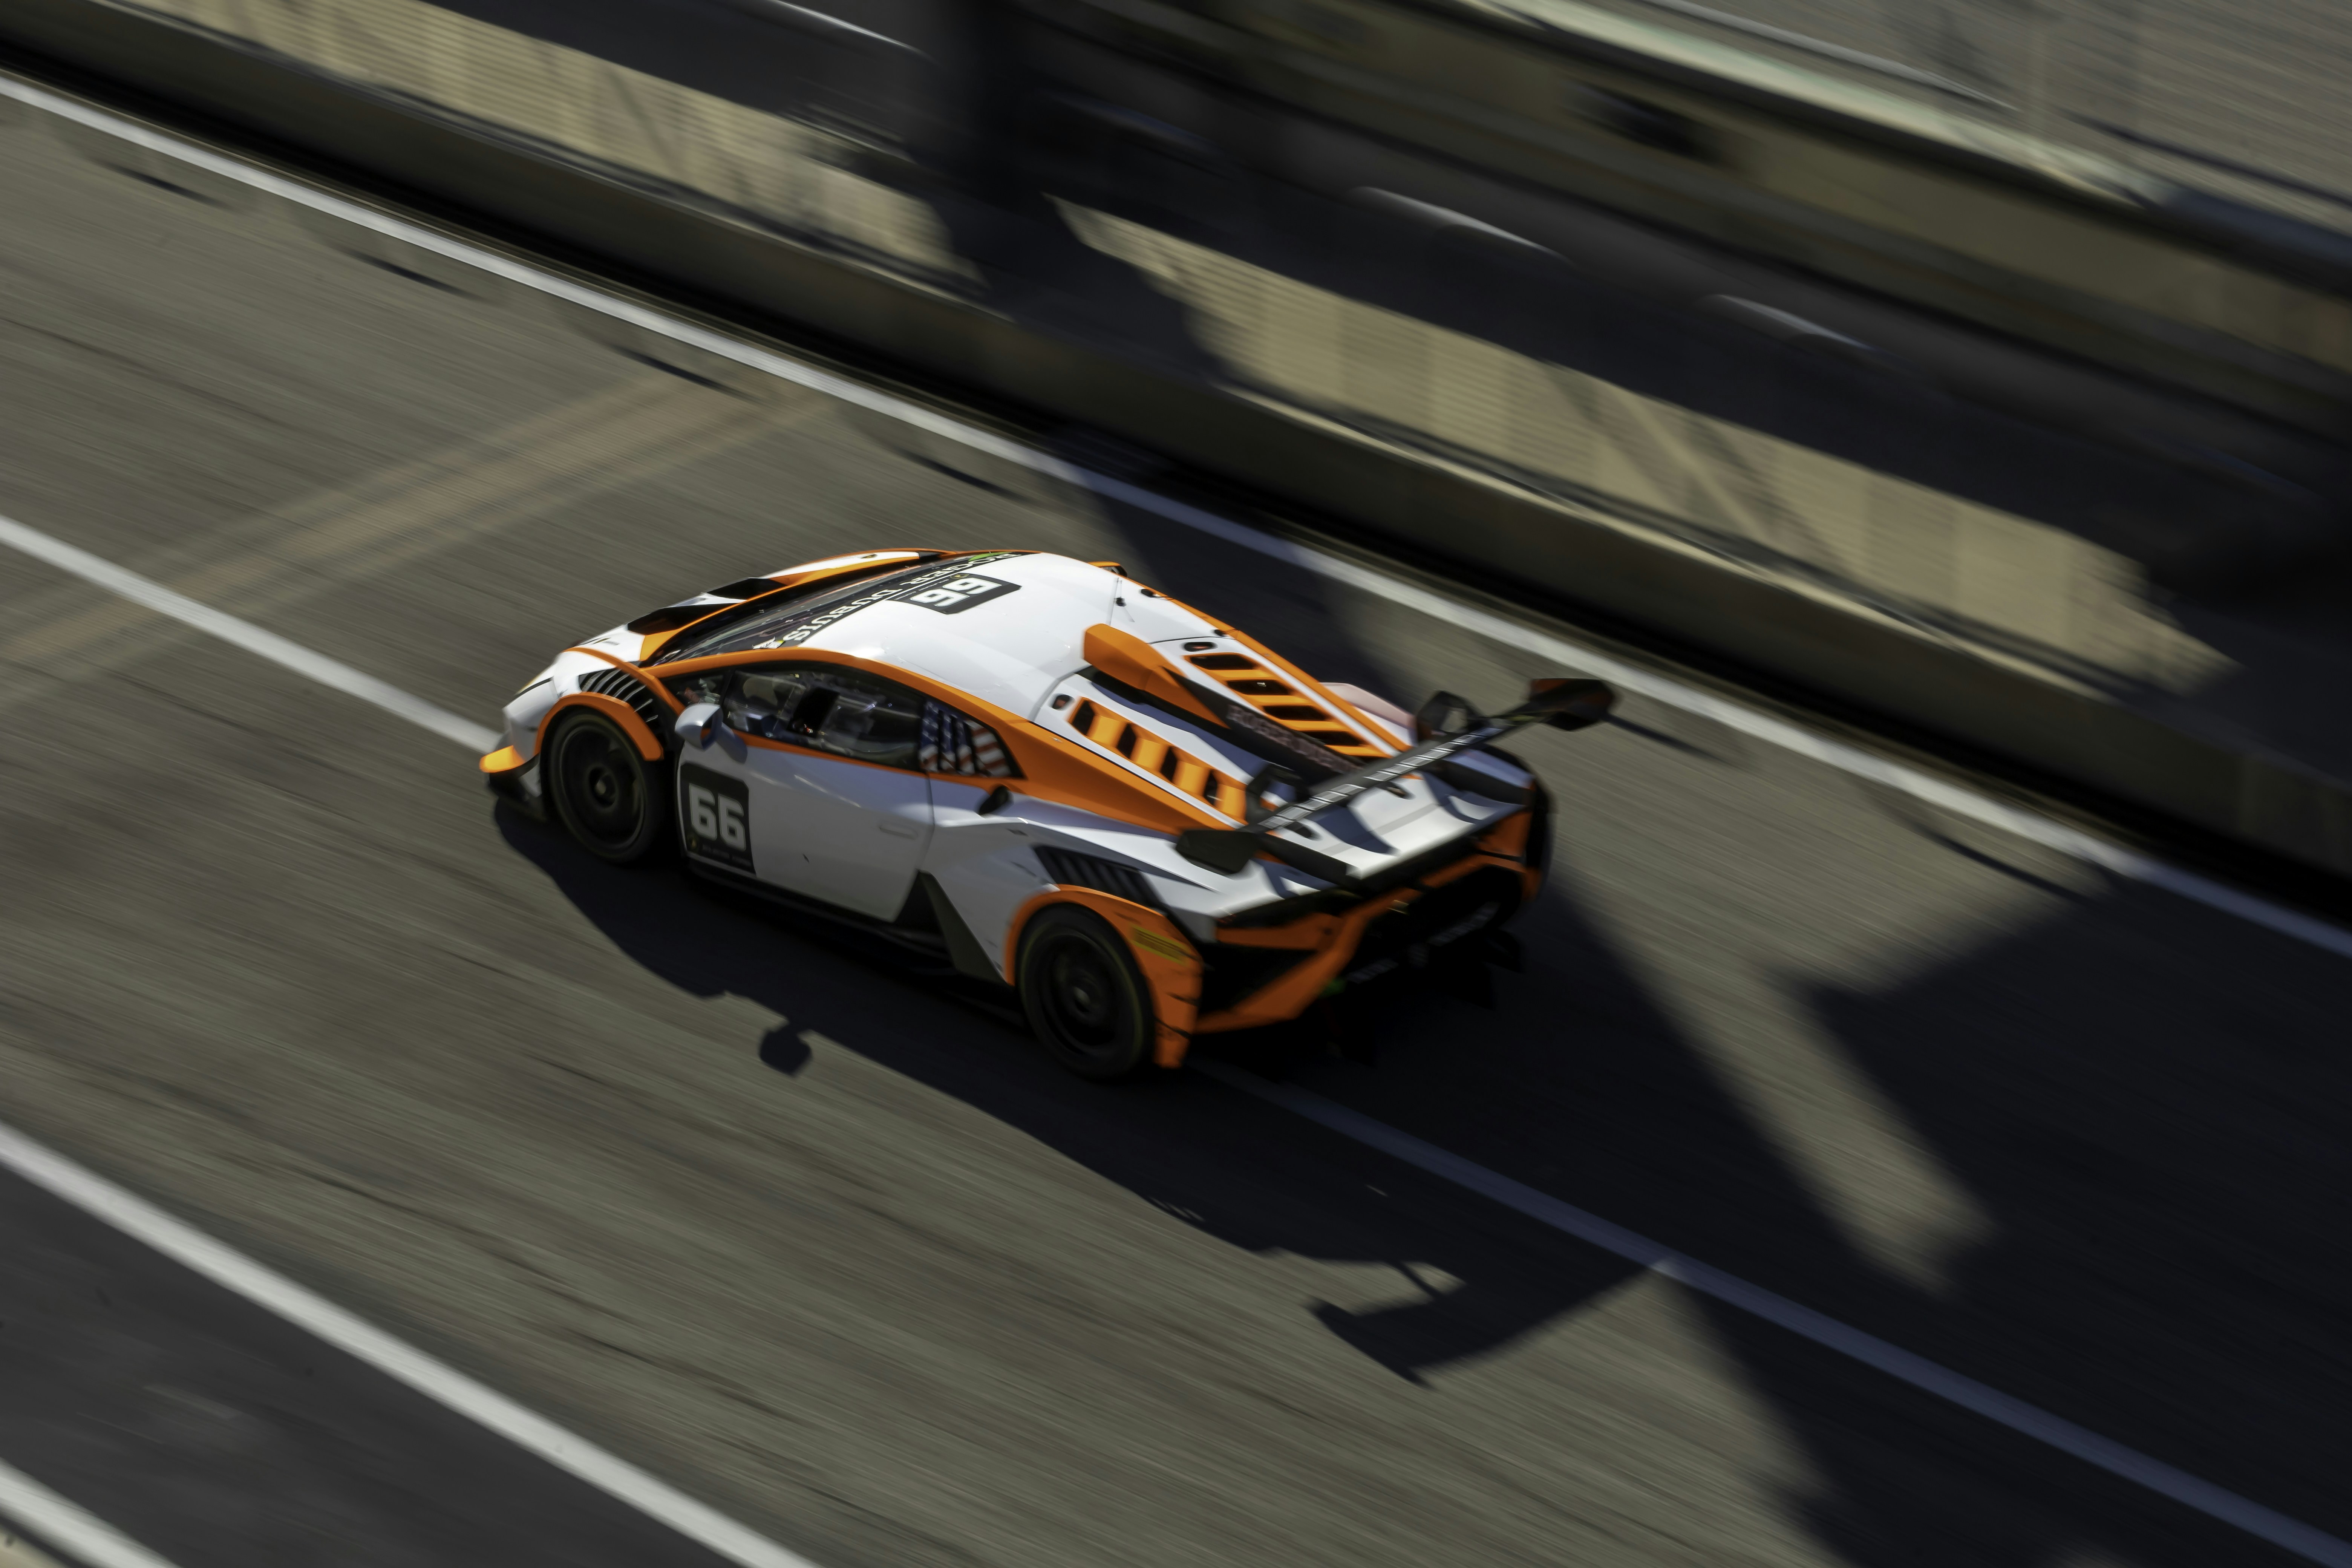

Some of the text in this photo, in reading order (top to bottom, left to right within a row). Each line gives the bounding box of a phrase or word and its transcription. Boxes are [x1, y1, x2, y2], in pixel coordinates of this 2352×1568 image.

[899, 554, 1022, 585] ROGER
[909, 577, 1003, 607] 66
[782, 589, 903, 641] DUBUIS
[689, 783, 747, 852] 66
